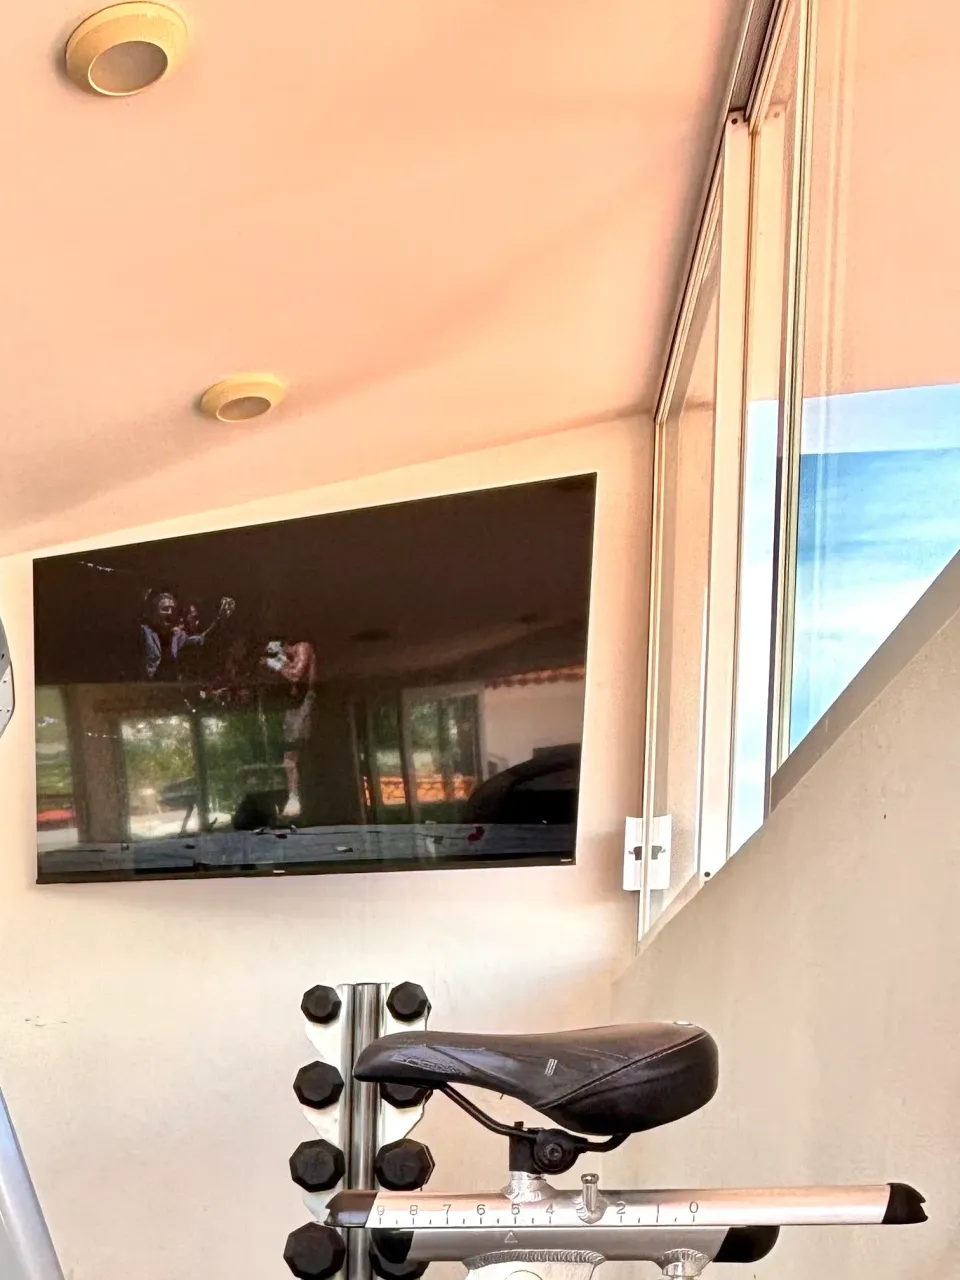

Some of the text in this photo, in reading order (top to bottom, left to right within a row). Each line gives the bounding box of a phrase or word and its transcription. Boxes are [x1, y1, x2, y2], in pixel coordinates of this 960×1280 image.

[377, 1204, 386, 1216] 9
[409, 1204, 419, 1216] 8
[443, 1203, 452, 1216] 7
[476, 1203, 486, 1216] 6
[510, 1203, 521, 1216] 5
[545, 1202, 555, 1215] 4
[616, 1200, 627, 1215] 2
[689, 1201, 699, 1214] 0
